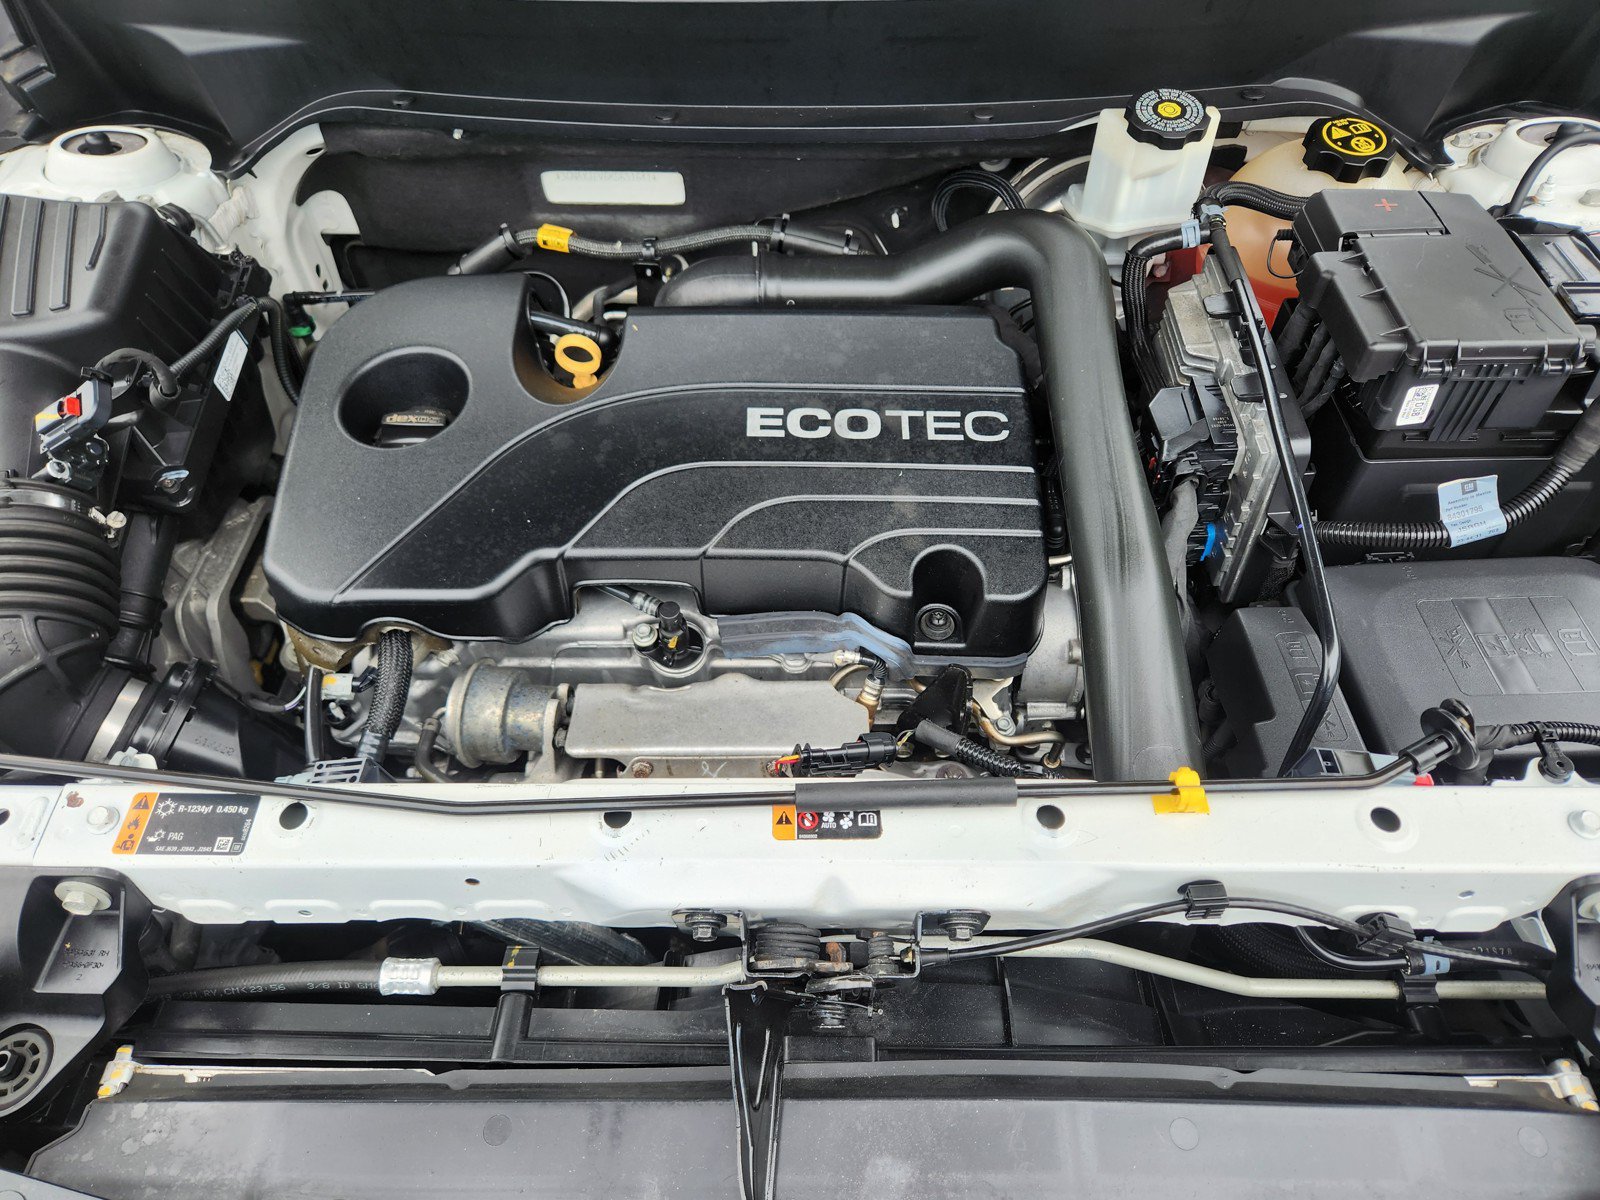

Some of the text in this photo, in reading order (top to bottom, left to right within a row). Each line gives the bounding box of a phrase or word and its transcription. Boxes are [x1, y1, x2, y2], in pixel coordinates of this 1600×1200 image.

[746, 406, 1010, 442] ECOTEC
[177, 805, 249, 815] R-1234yf 0.450 kg
[167, 832, 184, 841] PAG
